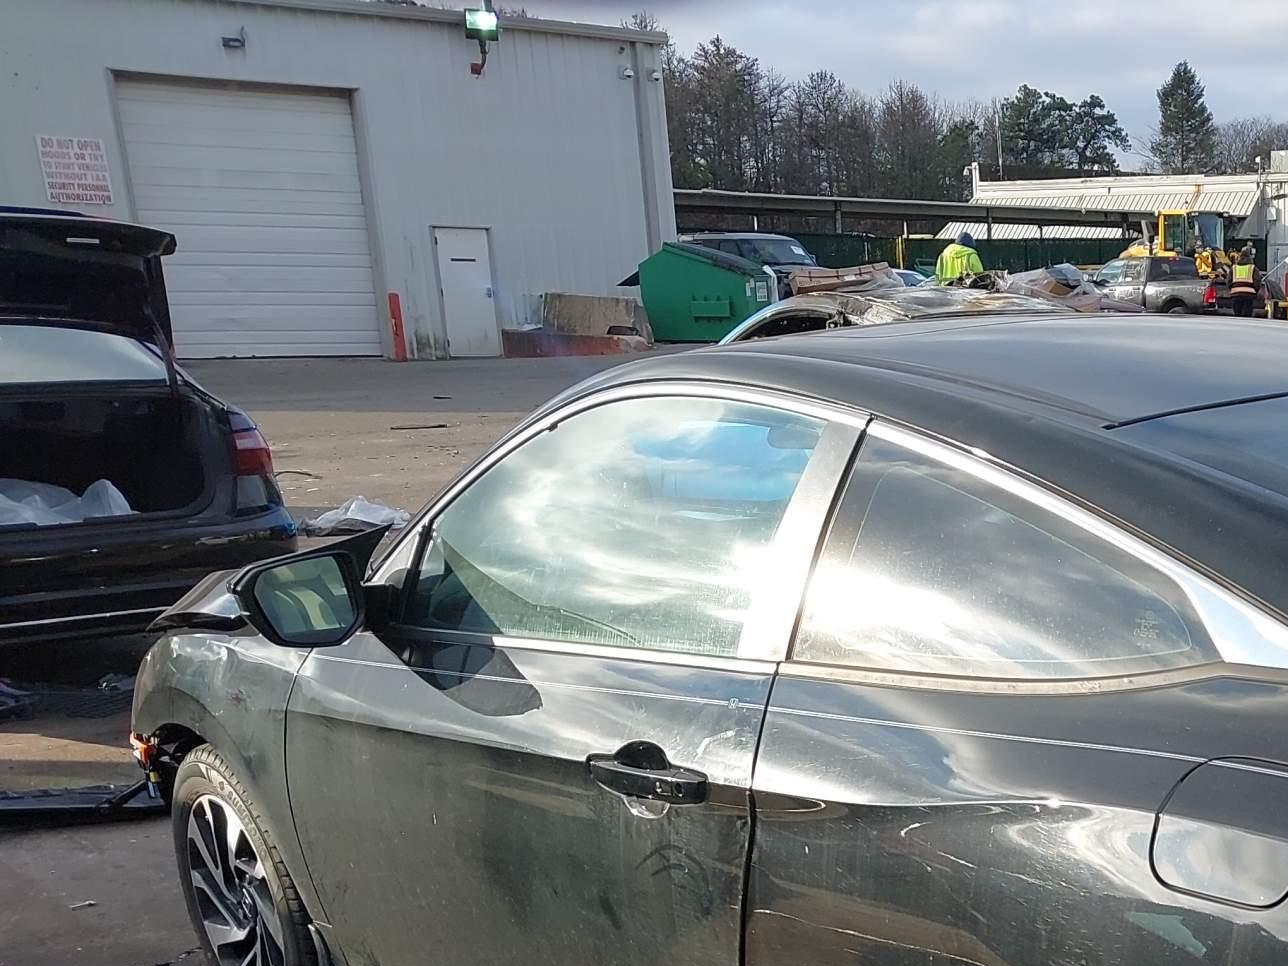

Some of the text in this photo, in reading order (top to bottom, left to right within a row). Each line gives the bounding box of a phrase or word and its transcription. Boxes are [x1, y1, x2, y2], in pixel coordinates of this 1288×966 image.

[40, 136, 102, 152] DO NOT OPEN
[73, 151, 86, 161] OR
[88, 152, 105, 163] TRY
[46, 170, 88, 182] WITHOUT
[47, 181, 112, 194] SECURITY PERSONNEL
[49, 191, 112, 203] AUTHORIZATION
